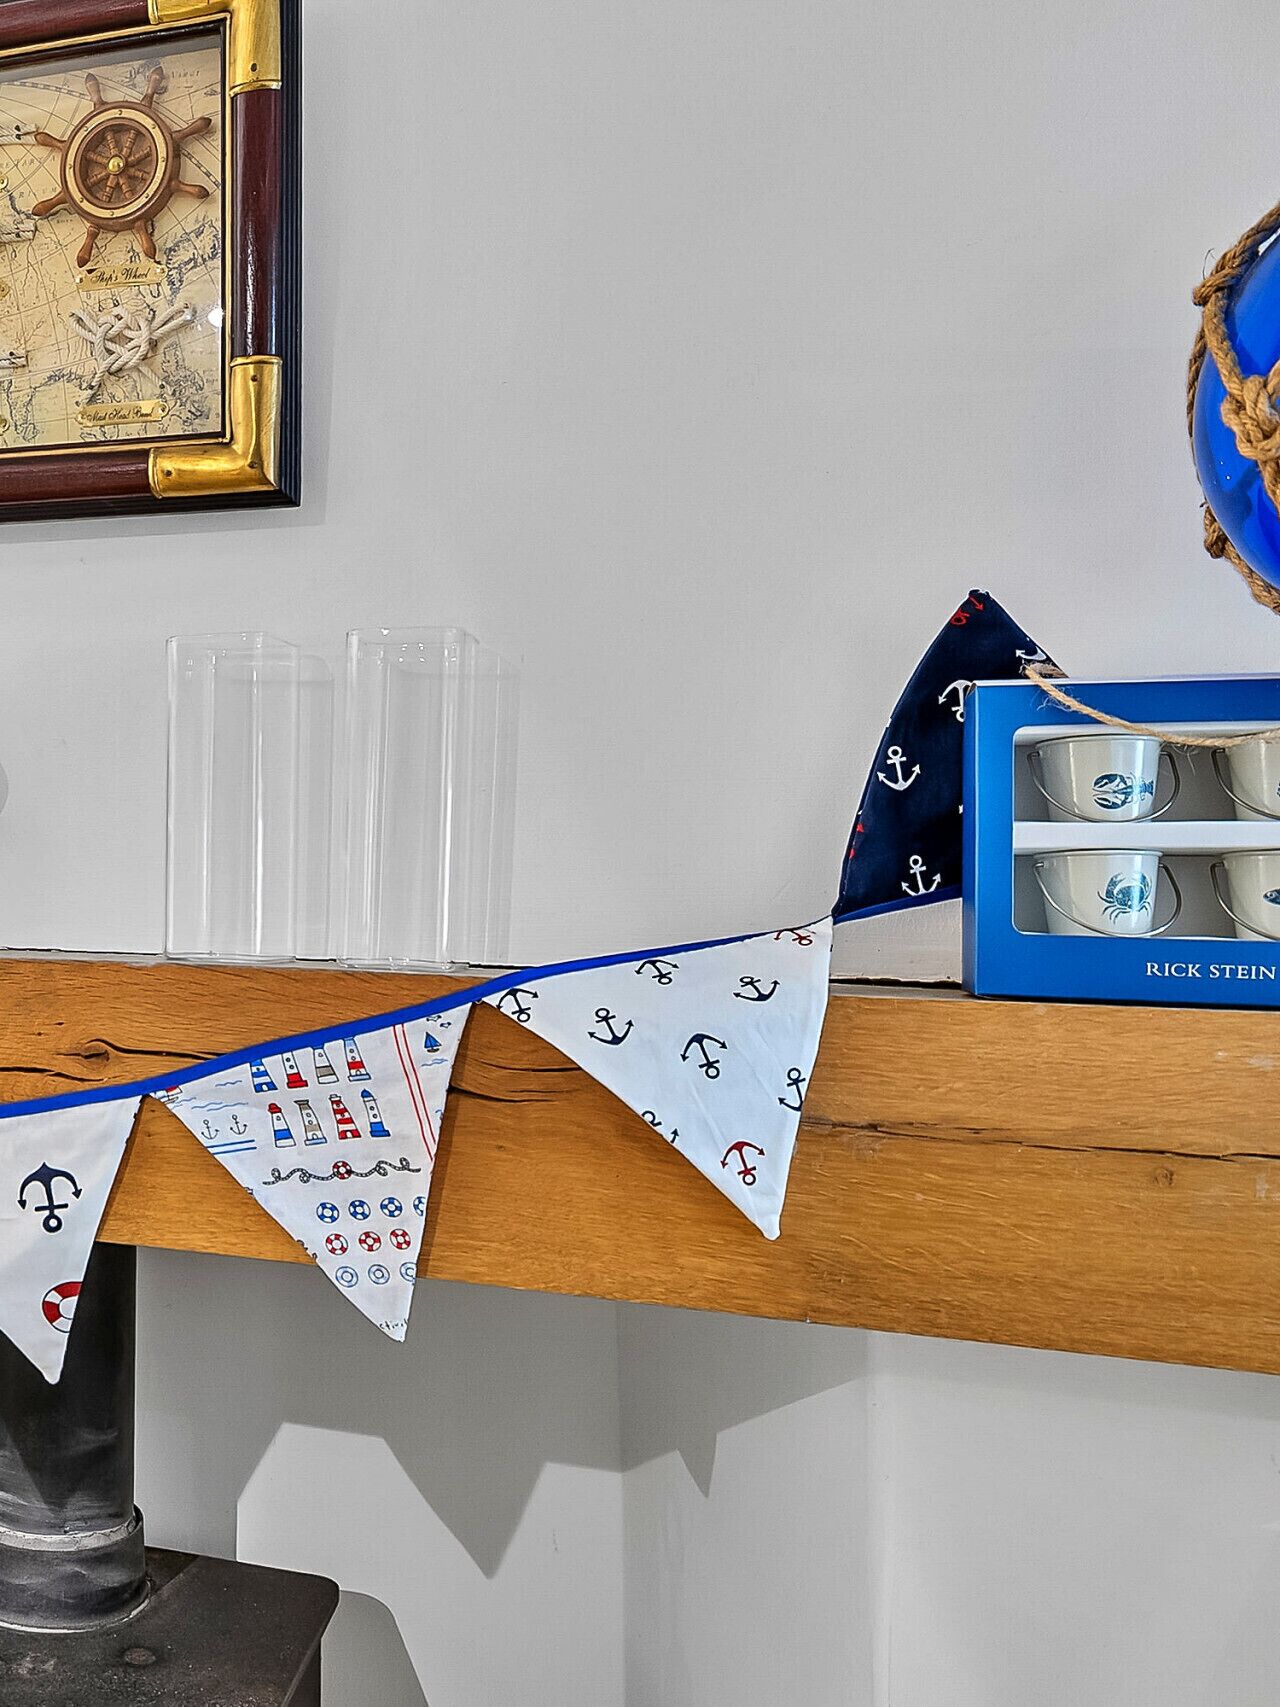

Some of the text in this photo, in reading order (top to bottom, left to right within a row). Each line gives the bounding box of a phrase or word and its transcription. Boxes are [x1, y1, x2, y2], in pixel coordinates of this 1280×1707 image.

[91, 267, 151, 286] Ship's Wheel
[1146, 962, 1277, 980] RICK STEIN
